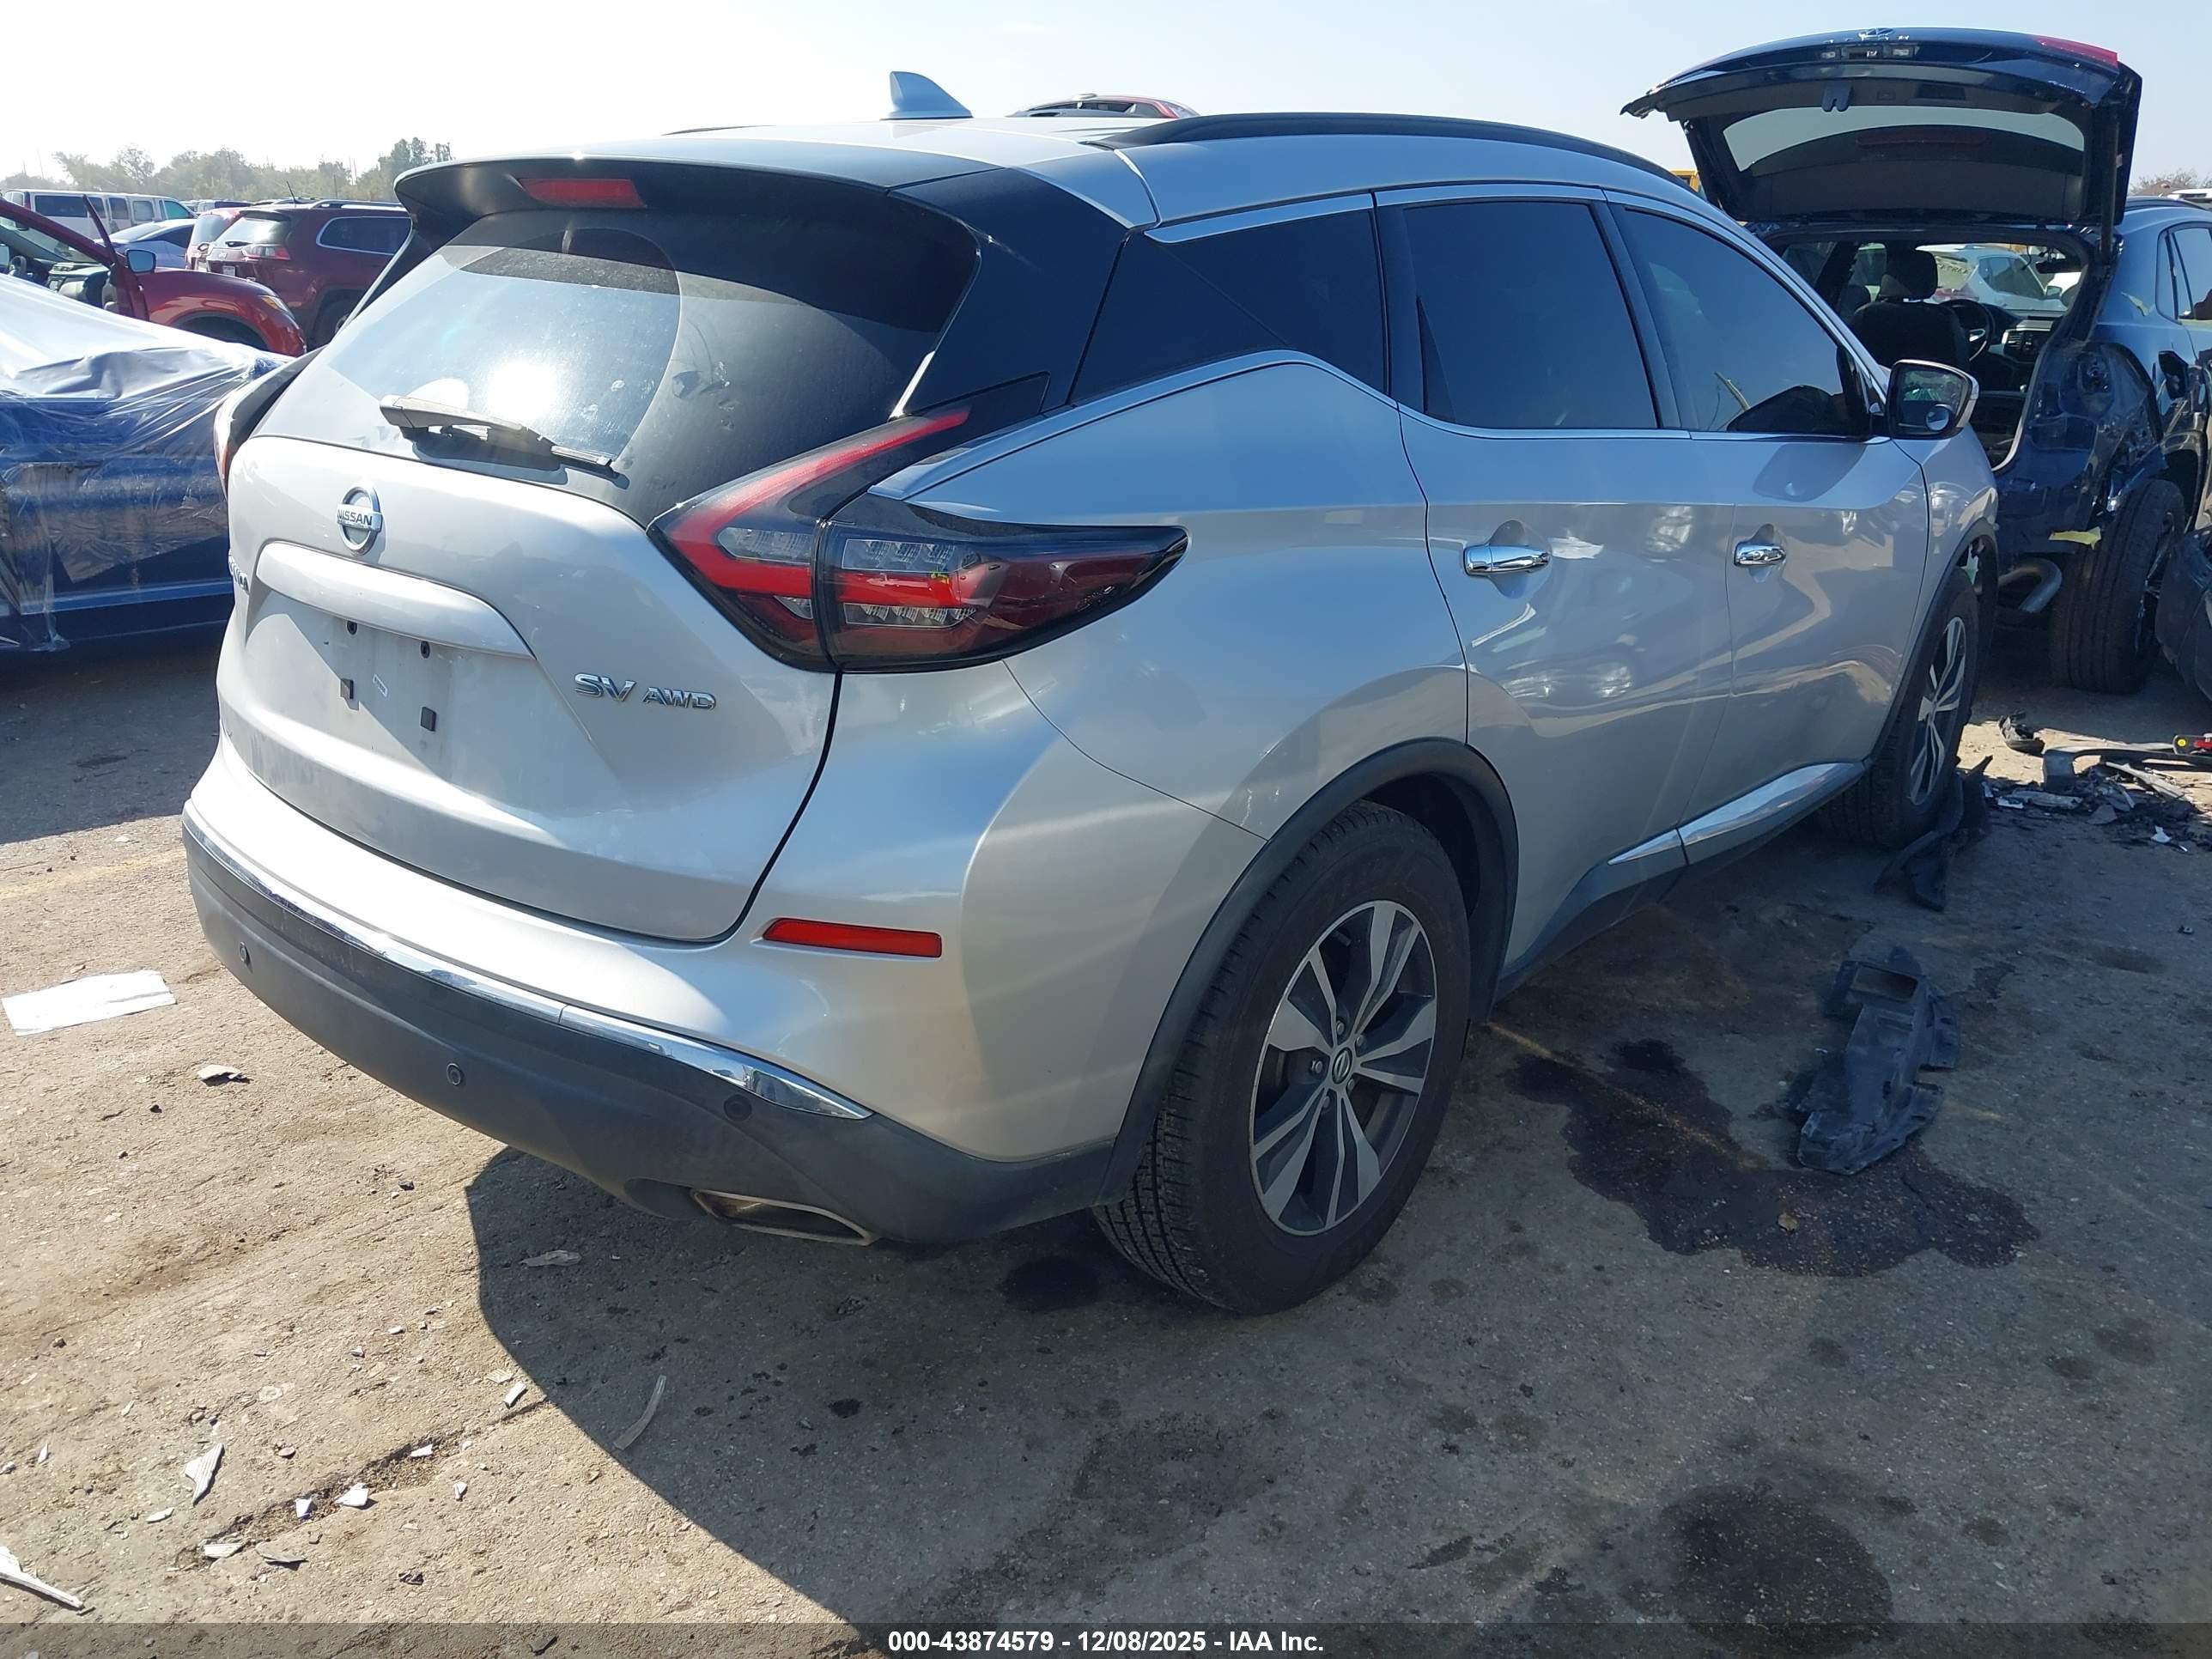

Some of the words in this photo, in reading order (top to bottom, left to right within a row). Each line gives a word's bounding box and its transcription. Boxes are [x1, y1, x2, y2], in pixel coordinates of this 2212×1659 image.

[337, 508, 373, 526] NISSAN
[574, 673, 636, 702] SV
[642, 687, 716, 711] AWD
